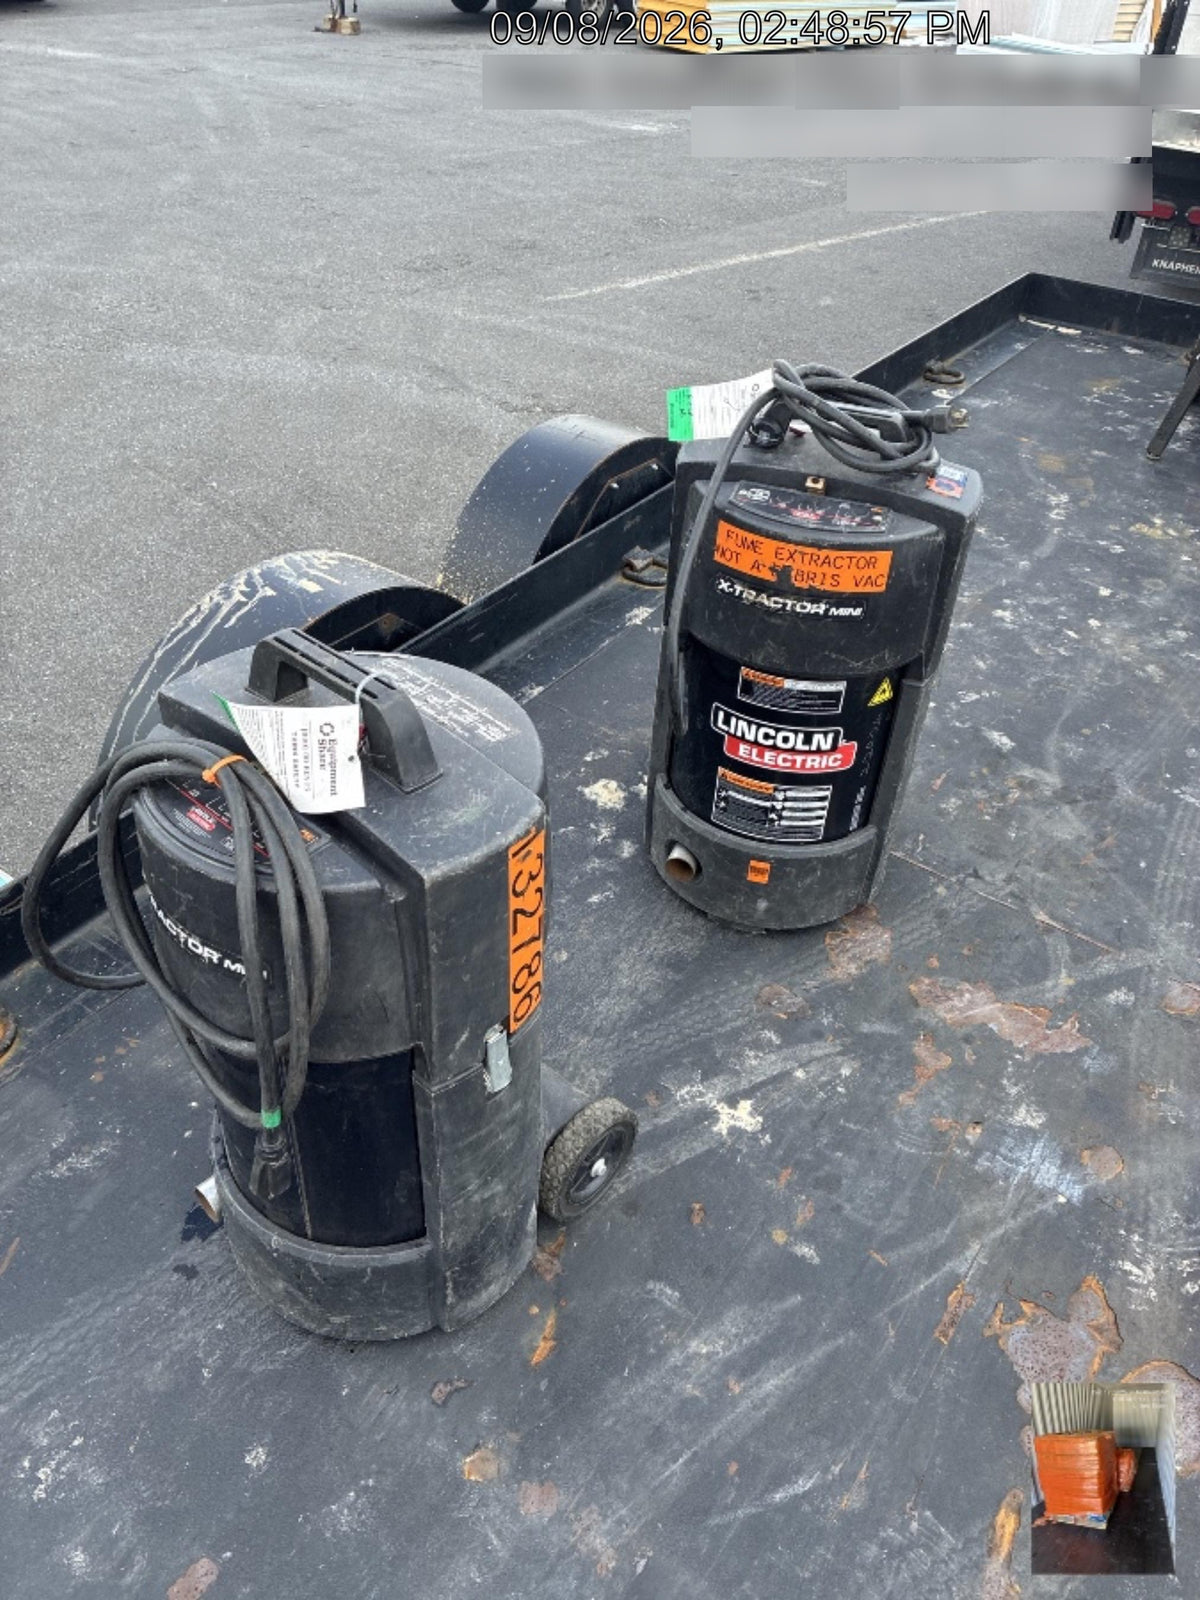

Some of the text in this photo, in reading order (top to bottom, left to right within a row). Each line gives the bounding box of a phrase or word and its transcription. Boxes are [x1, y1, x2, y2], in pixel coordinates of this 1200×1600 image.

[716, 545, 741, 564] NOT
[852, 573, 886, 589] VAC
[726, 529, 878, 571] FUME EXTRACTOR
[717, 578, 864, 617] X-TRACTOR MINI
[717, 710, 835, 750] LINCOLN
[327, 738, 338, 797] Equipment
[738, 743, 843, 769] ELECTRIC
[511, 829, 545, 1024] 132786
